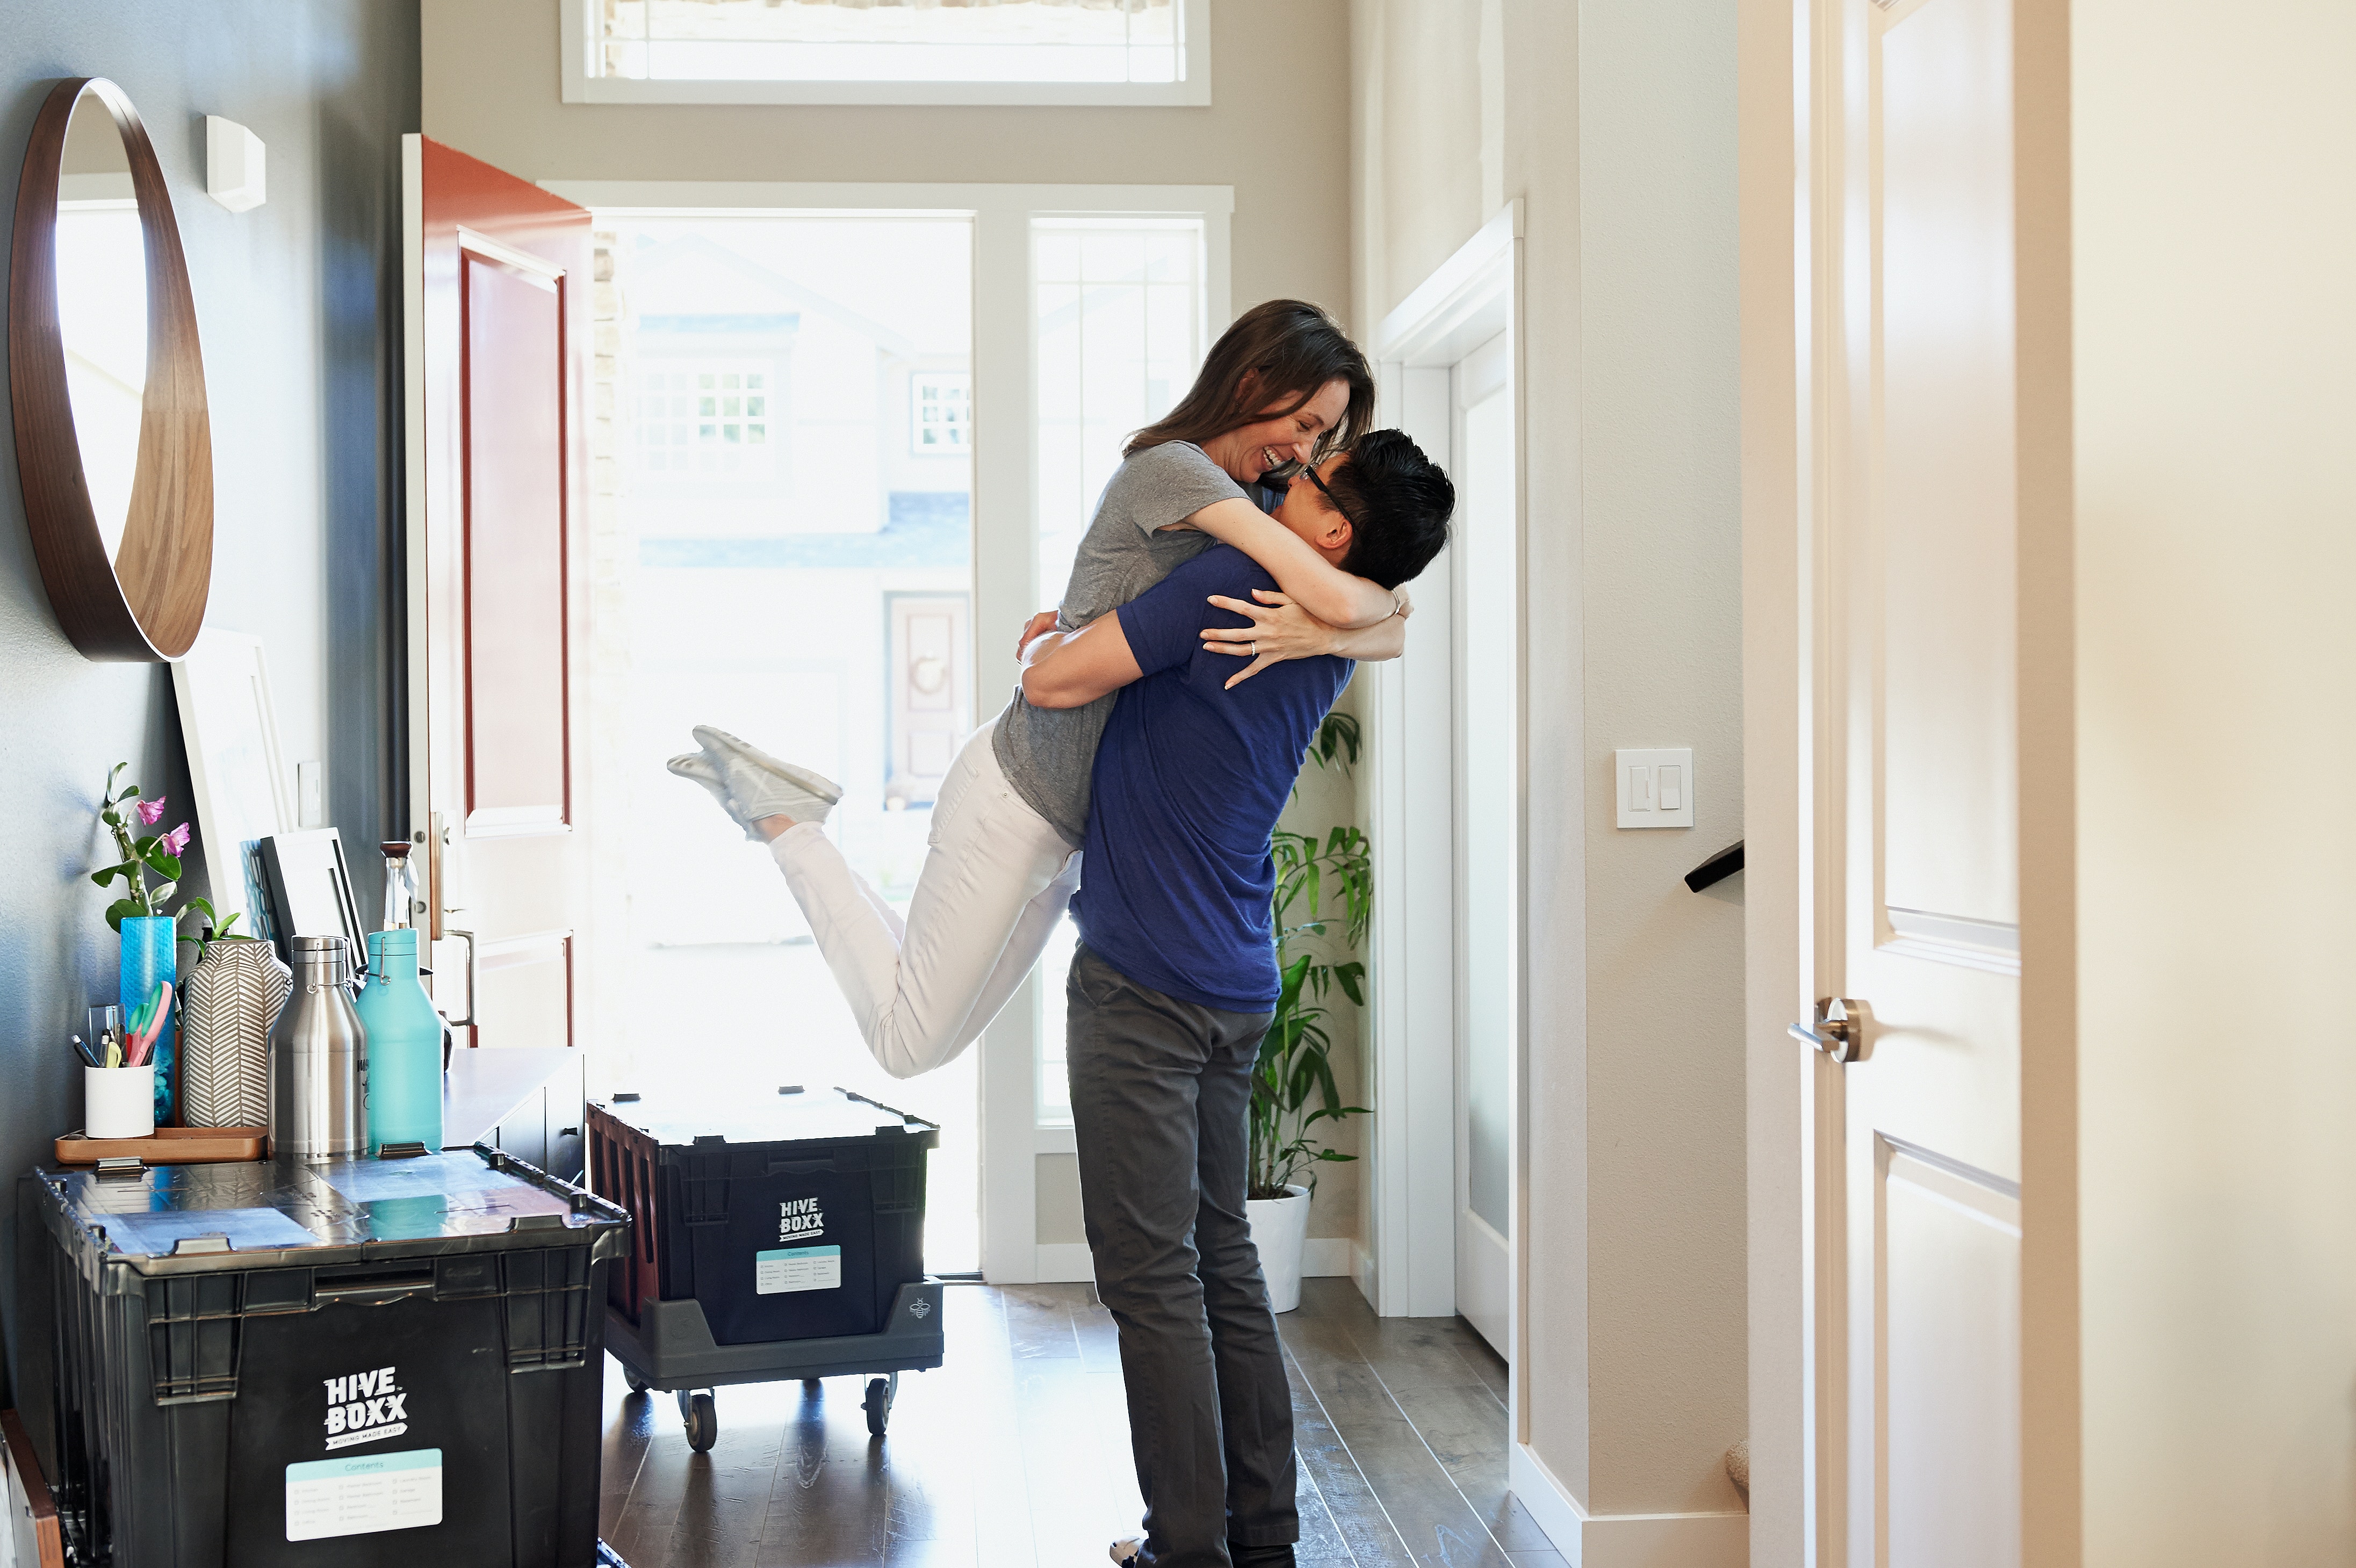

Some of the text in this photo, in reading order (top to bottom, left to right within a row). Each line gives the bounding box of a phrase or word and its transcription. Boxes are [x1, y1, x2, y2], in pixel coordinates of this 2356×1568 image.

[779, 1197, 818, 1217] HIVE
[779, 1212, 824, 1233] BOXX
[323, 1366, 396, 1405] HIVE
[323, 1393, 408, 1435] BOXX
[333, 1426, 401, 1445] MOVING MADE EASY
[345, 1462, 384, 1472] Contents
